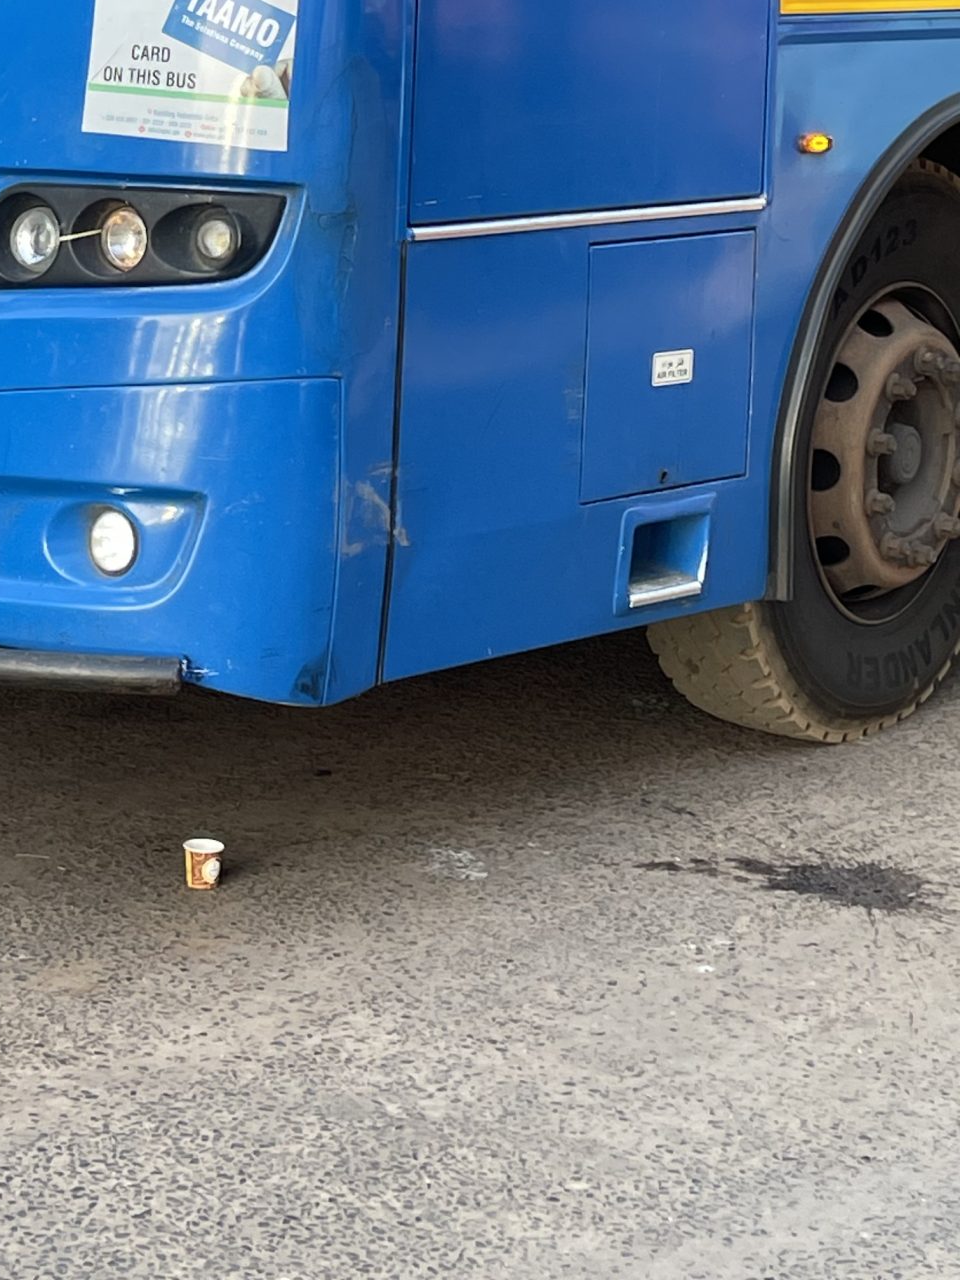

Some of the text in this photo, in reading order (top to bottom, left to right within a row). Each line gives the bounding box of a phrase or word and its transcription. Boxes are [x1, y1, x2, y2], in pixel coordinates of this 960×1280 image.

[181, 15, 195, 27] The
[131, 44, 171, 63] CARD
[103, 65, 197, 89] ON THIS BUS
